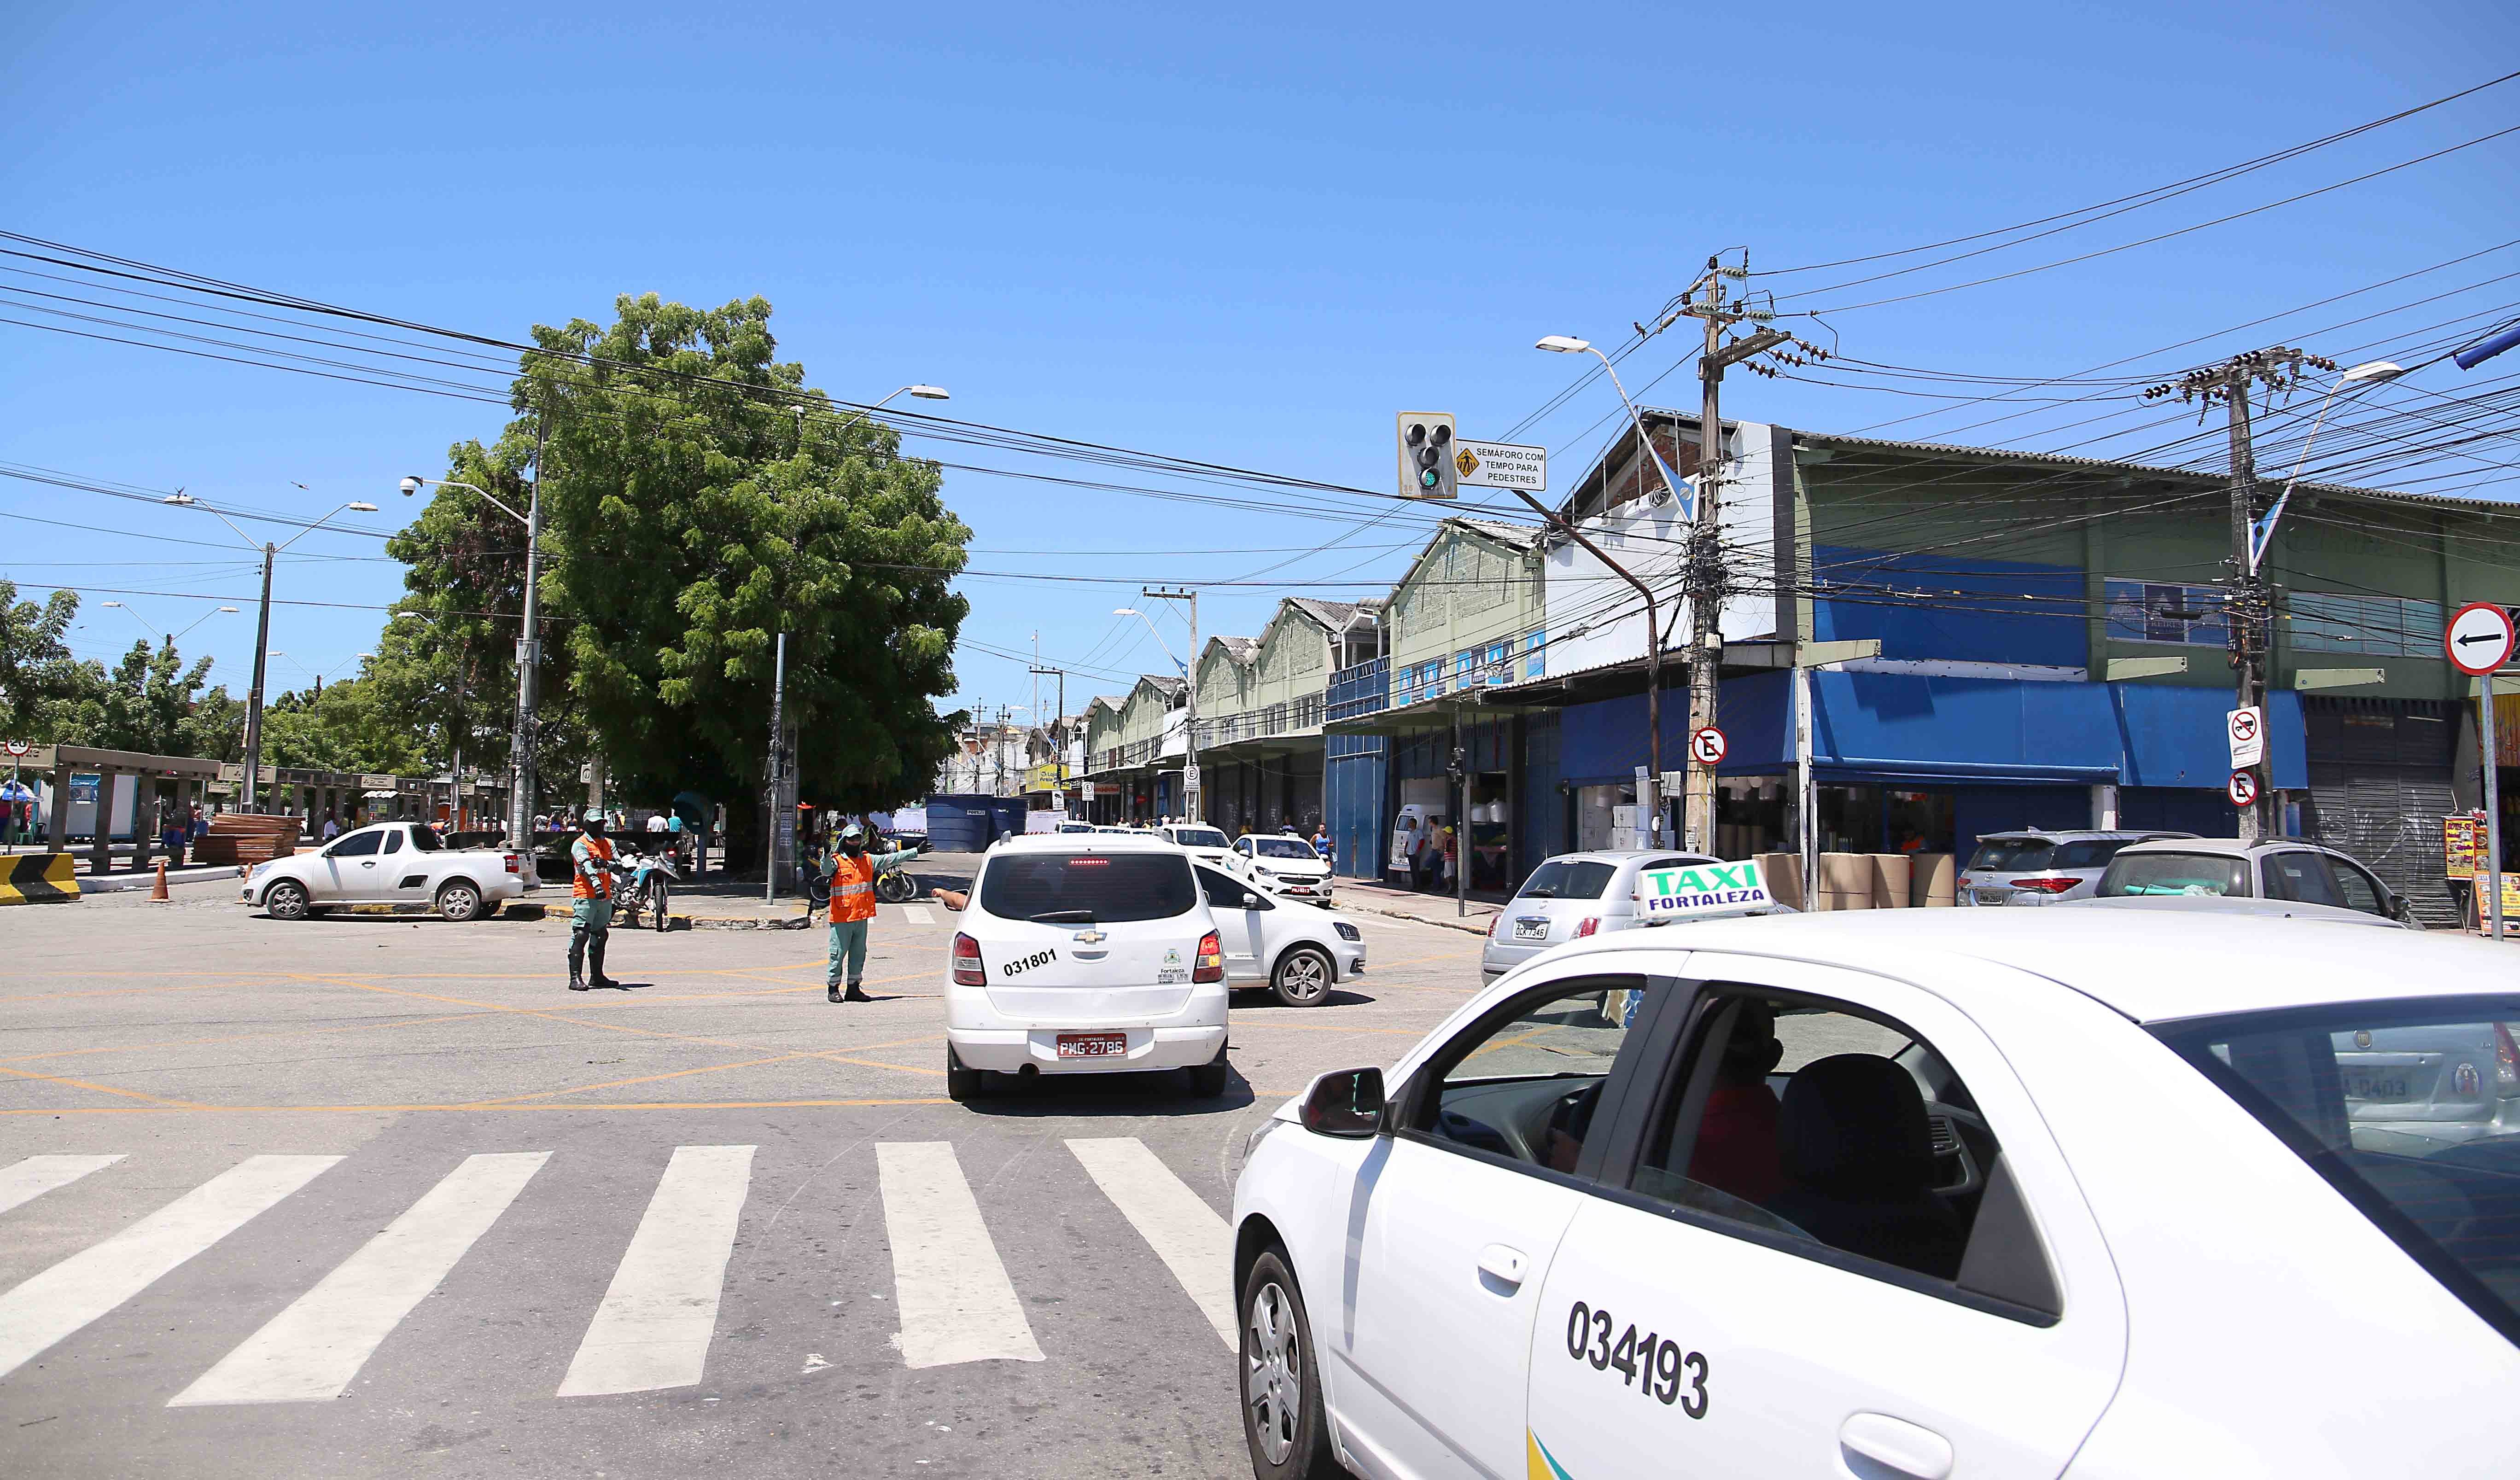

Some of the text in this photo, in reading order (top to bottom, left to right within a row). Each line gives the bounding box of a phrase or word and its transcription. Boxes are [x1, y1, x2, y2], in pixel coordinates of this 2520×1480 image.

[1476, 448, 1544, 461] SEMÁFORO COM
[1486, 461, 1539, 472] TEMPO PARA
[1488, 473, 1537, 484] PEDESTRES
[1648, 864, 1758, 896] TAXI
[1649, 889, 1764, 911] FORTALEZA
[1003, 949, 1057, 977] 031801
[1567, 1300, 1709, 1420] 034193
